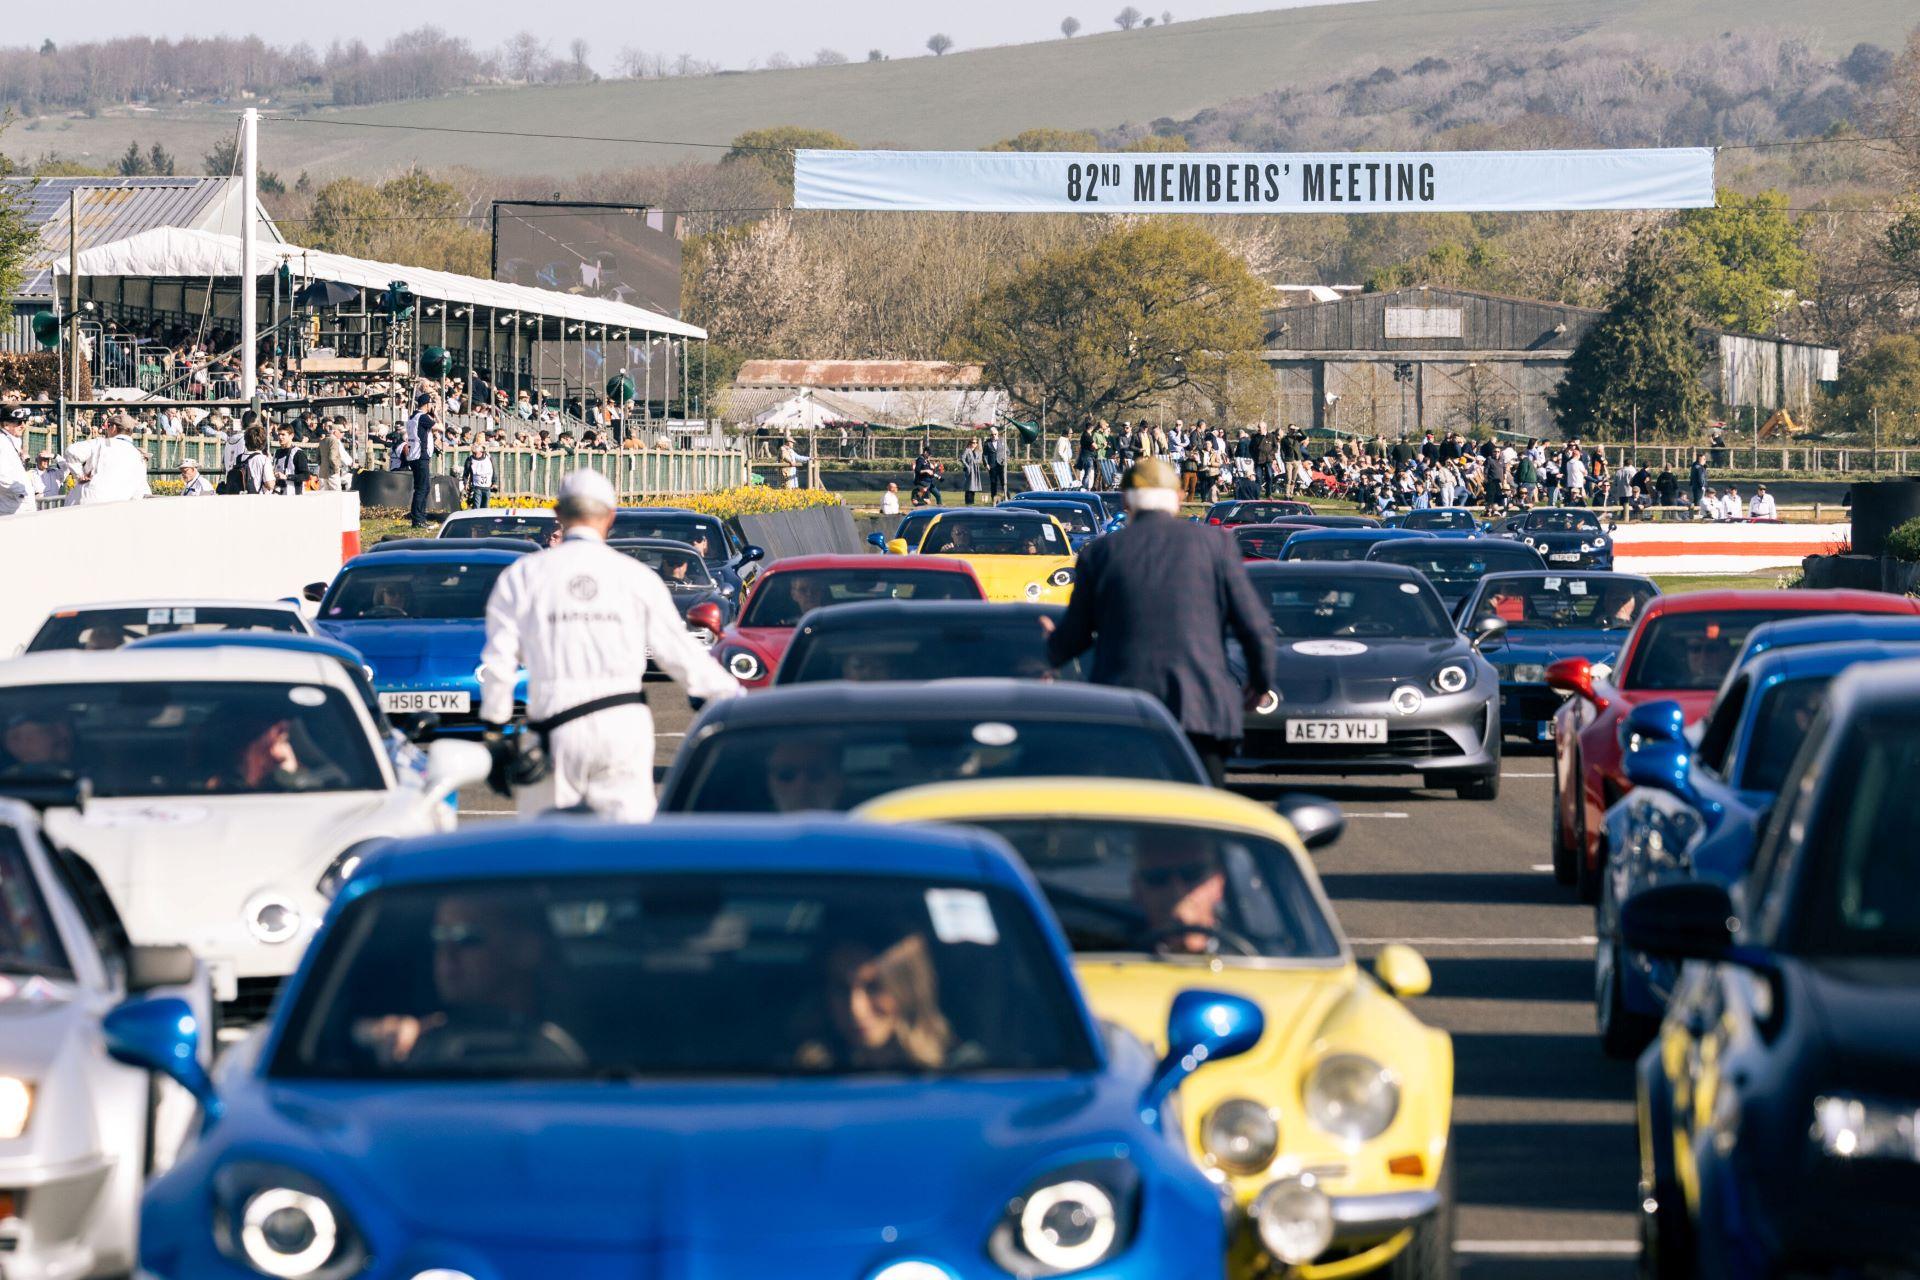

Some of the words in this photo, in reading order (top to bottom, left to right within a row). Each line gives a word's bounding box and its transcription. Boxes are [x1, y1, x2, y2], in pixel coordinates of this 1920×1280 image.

[1302, 162, 1435, 203] MEETING
[389, 694, 424, 710] HS18
[428, 694, 459, 709] CVK
[1294, 722, 1340, 739] AE73
[1345, 722, 1380, 739] VHJ
